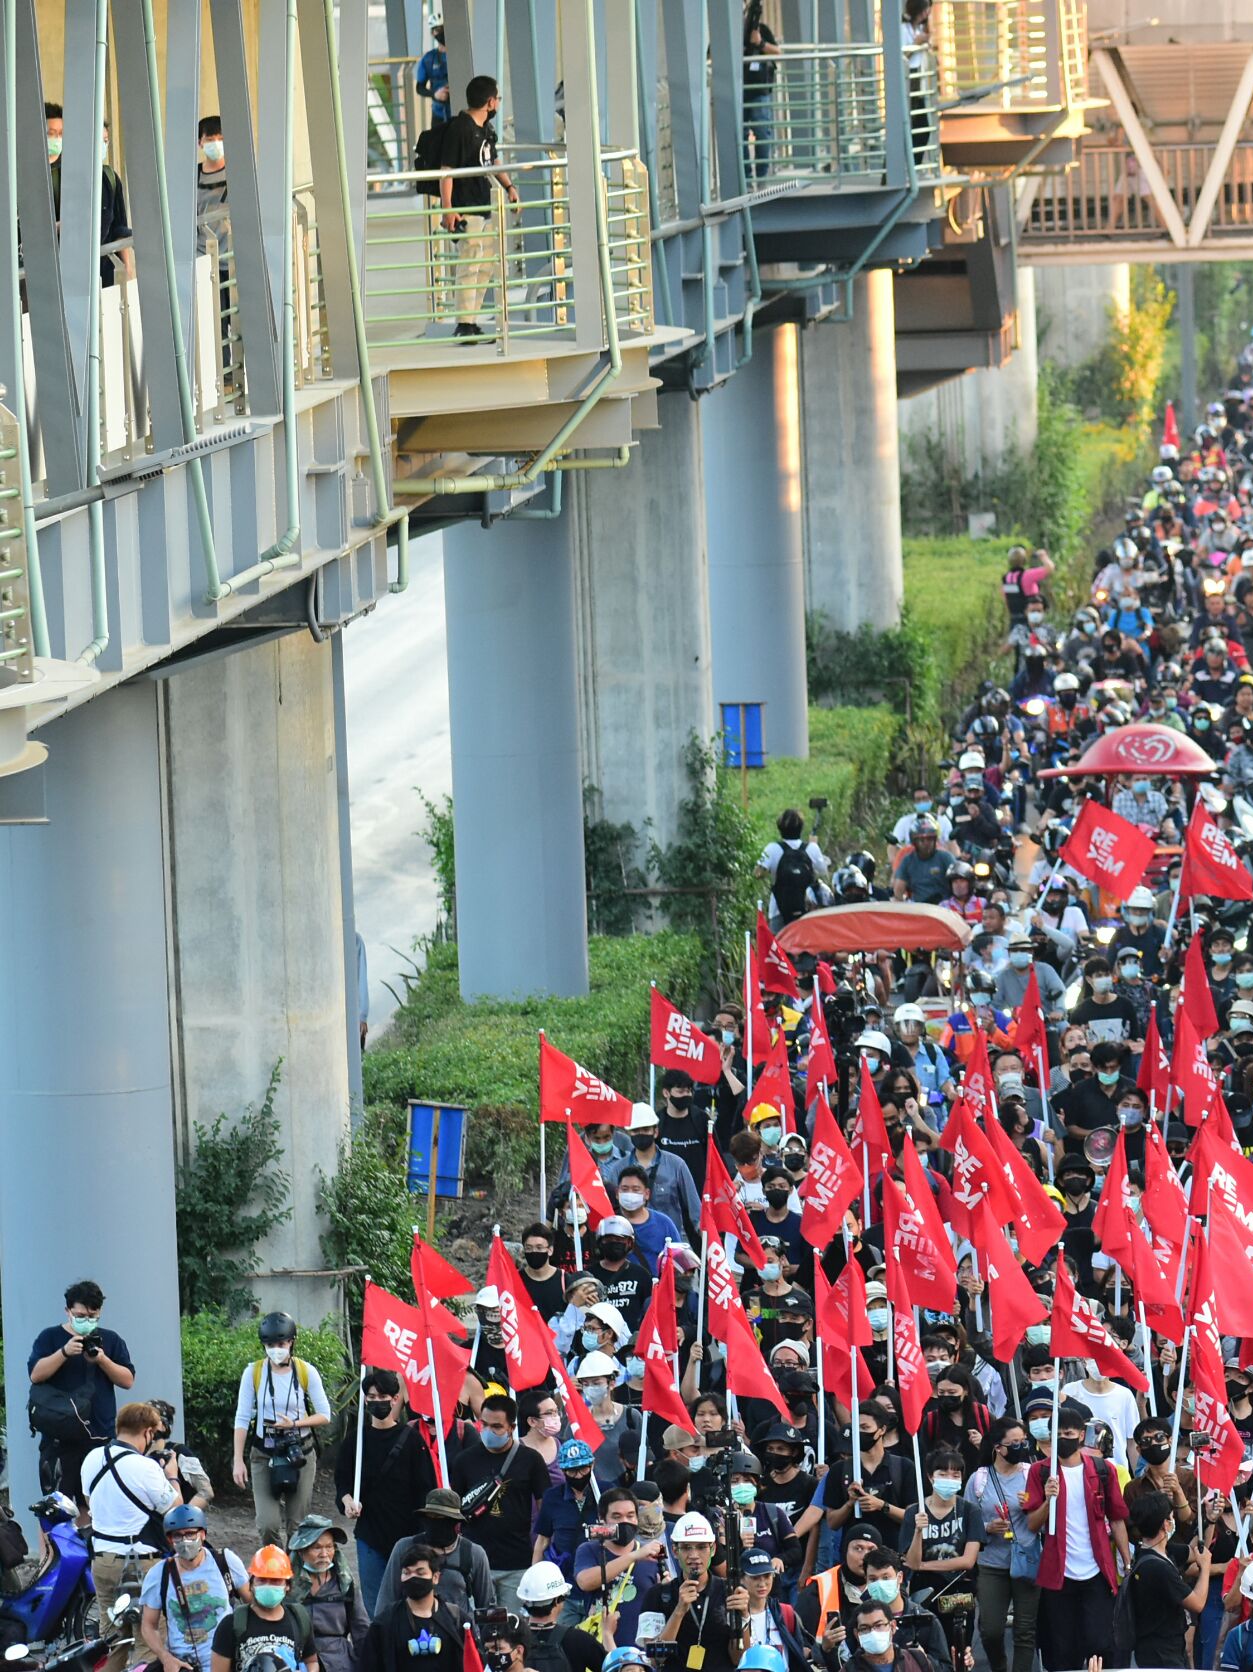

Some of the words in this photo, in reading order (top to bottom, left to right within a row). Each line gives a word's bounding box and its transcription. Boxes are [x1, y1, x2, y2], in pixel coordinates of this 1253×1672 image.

[1091, 826, 1119, 851] RE
[667, 1011, 692, 1037] RE
[1211, 1162, 1238, 1199] RE
[384, 1319, 418, 1355] RE
